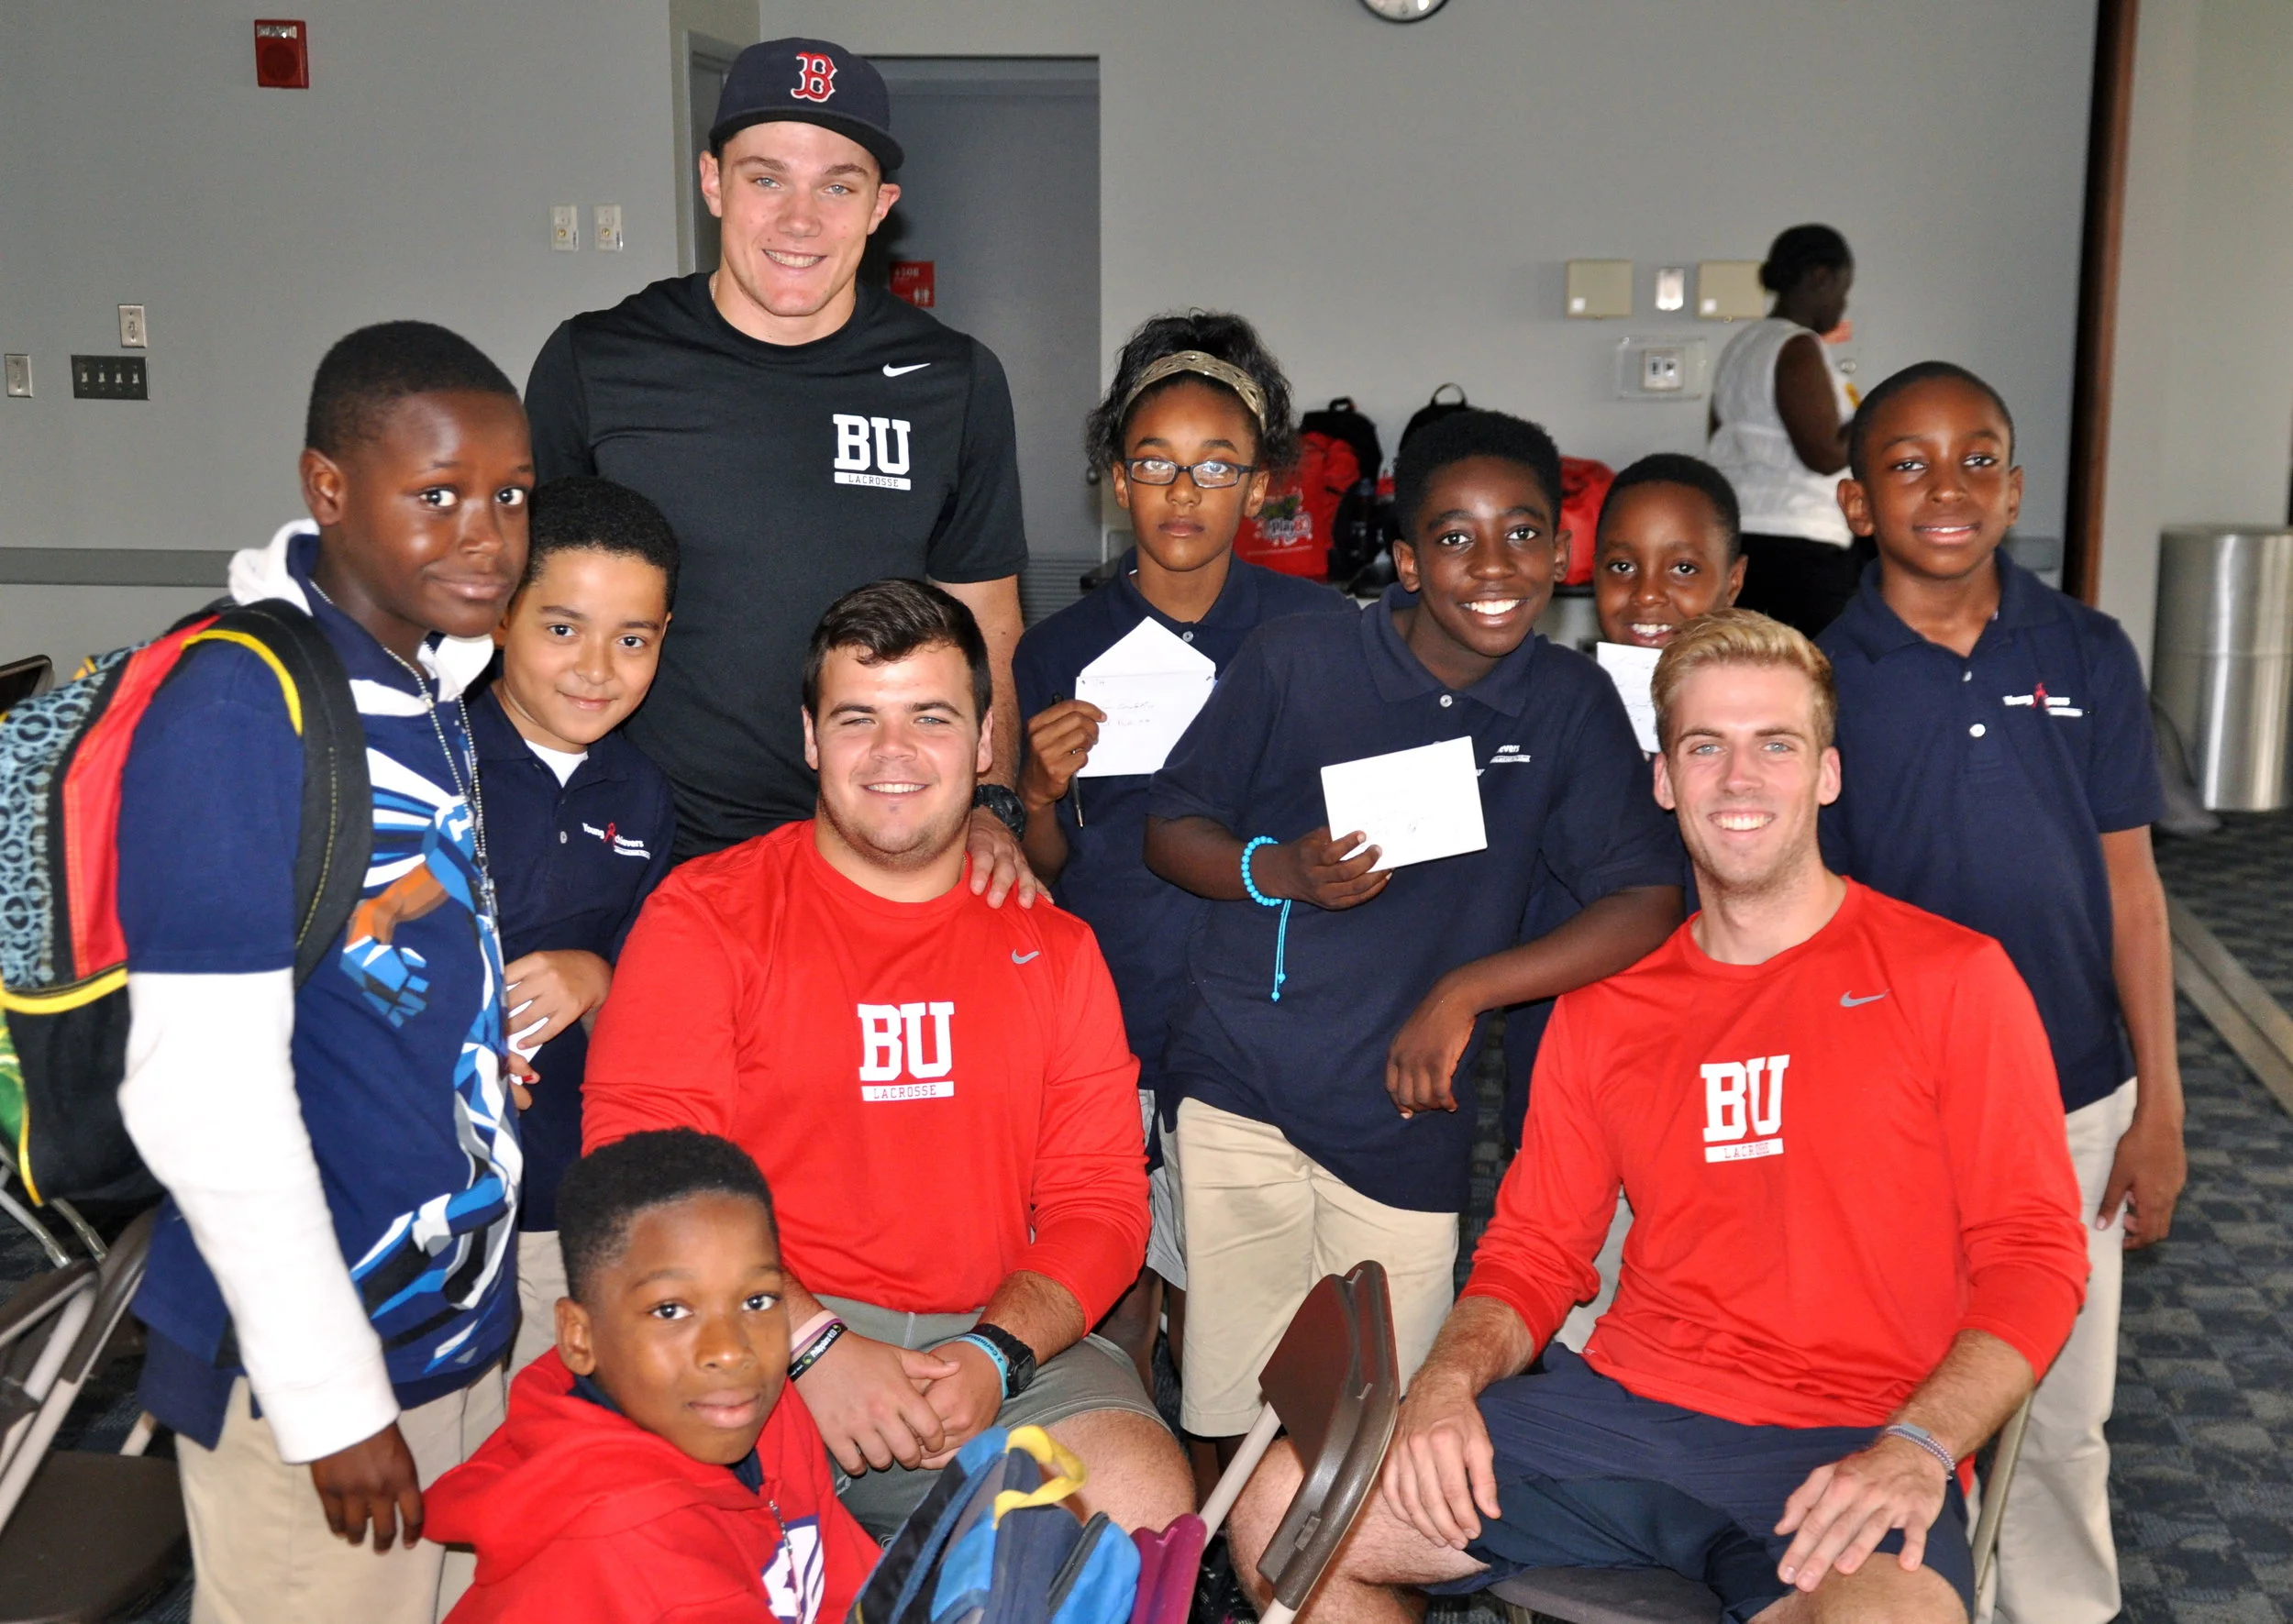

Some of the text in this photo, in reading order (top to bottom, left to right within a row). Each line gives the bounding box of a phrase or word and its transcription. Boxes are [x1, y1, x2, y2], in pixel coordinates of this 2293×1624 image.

[791, 51, 837, 103] B
[833, 414, 911, 475] BU
[848, 474, 899, 488] LACROSSE
[582, 822, 605, 839] Young
[857, 1001, 955, 1081] BU
[873, 1085, 936, 1099] LACROSSE
[1700, 1054, 1790, 1143] BU
